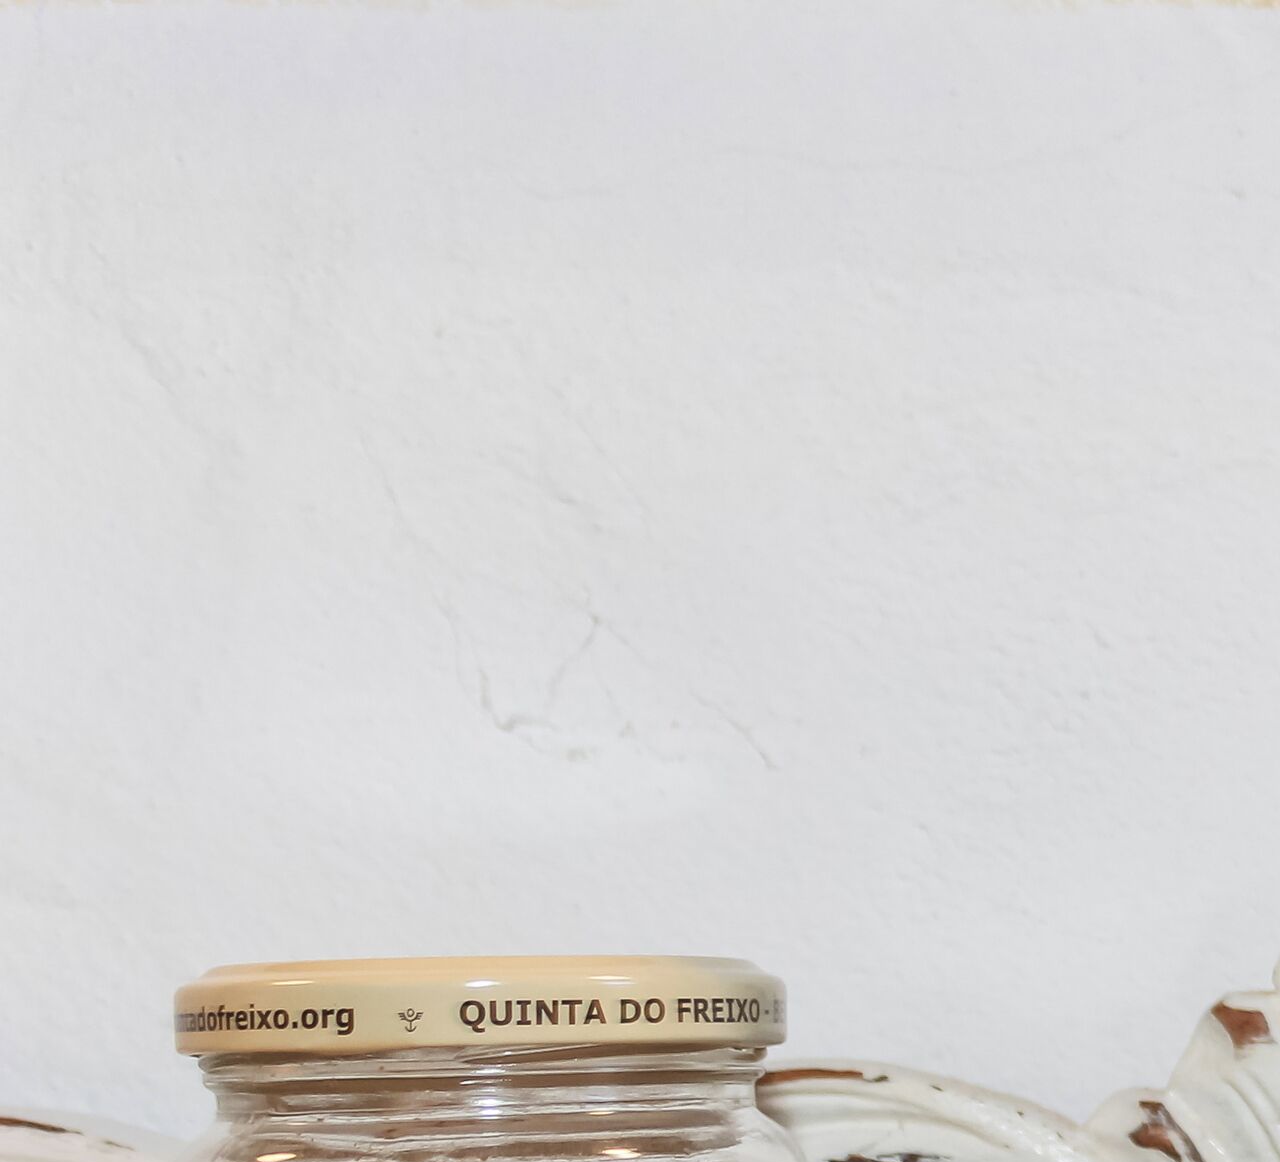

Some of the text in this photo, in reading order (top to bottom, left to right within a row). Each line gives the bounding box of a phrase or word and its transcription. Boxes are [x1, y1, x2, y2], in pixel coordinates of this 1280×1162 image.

[458, 1000, 606, 1033] QUINTA
[620, 999, 667, 1025] DO
[677, 998, 760, 1023] FREIXO
